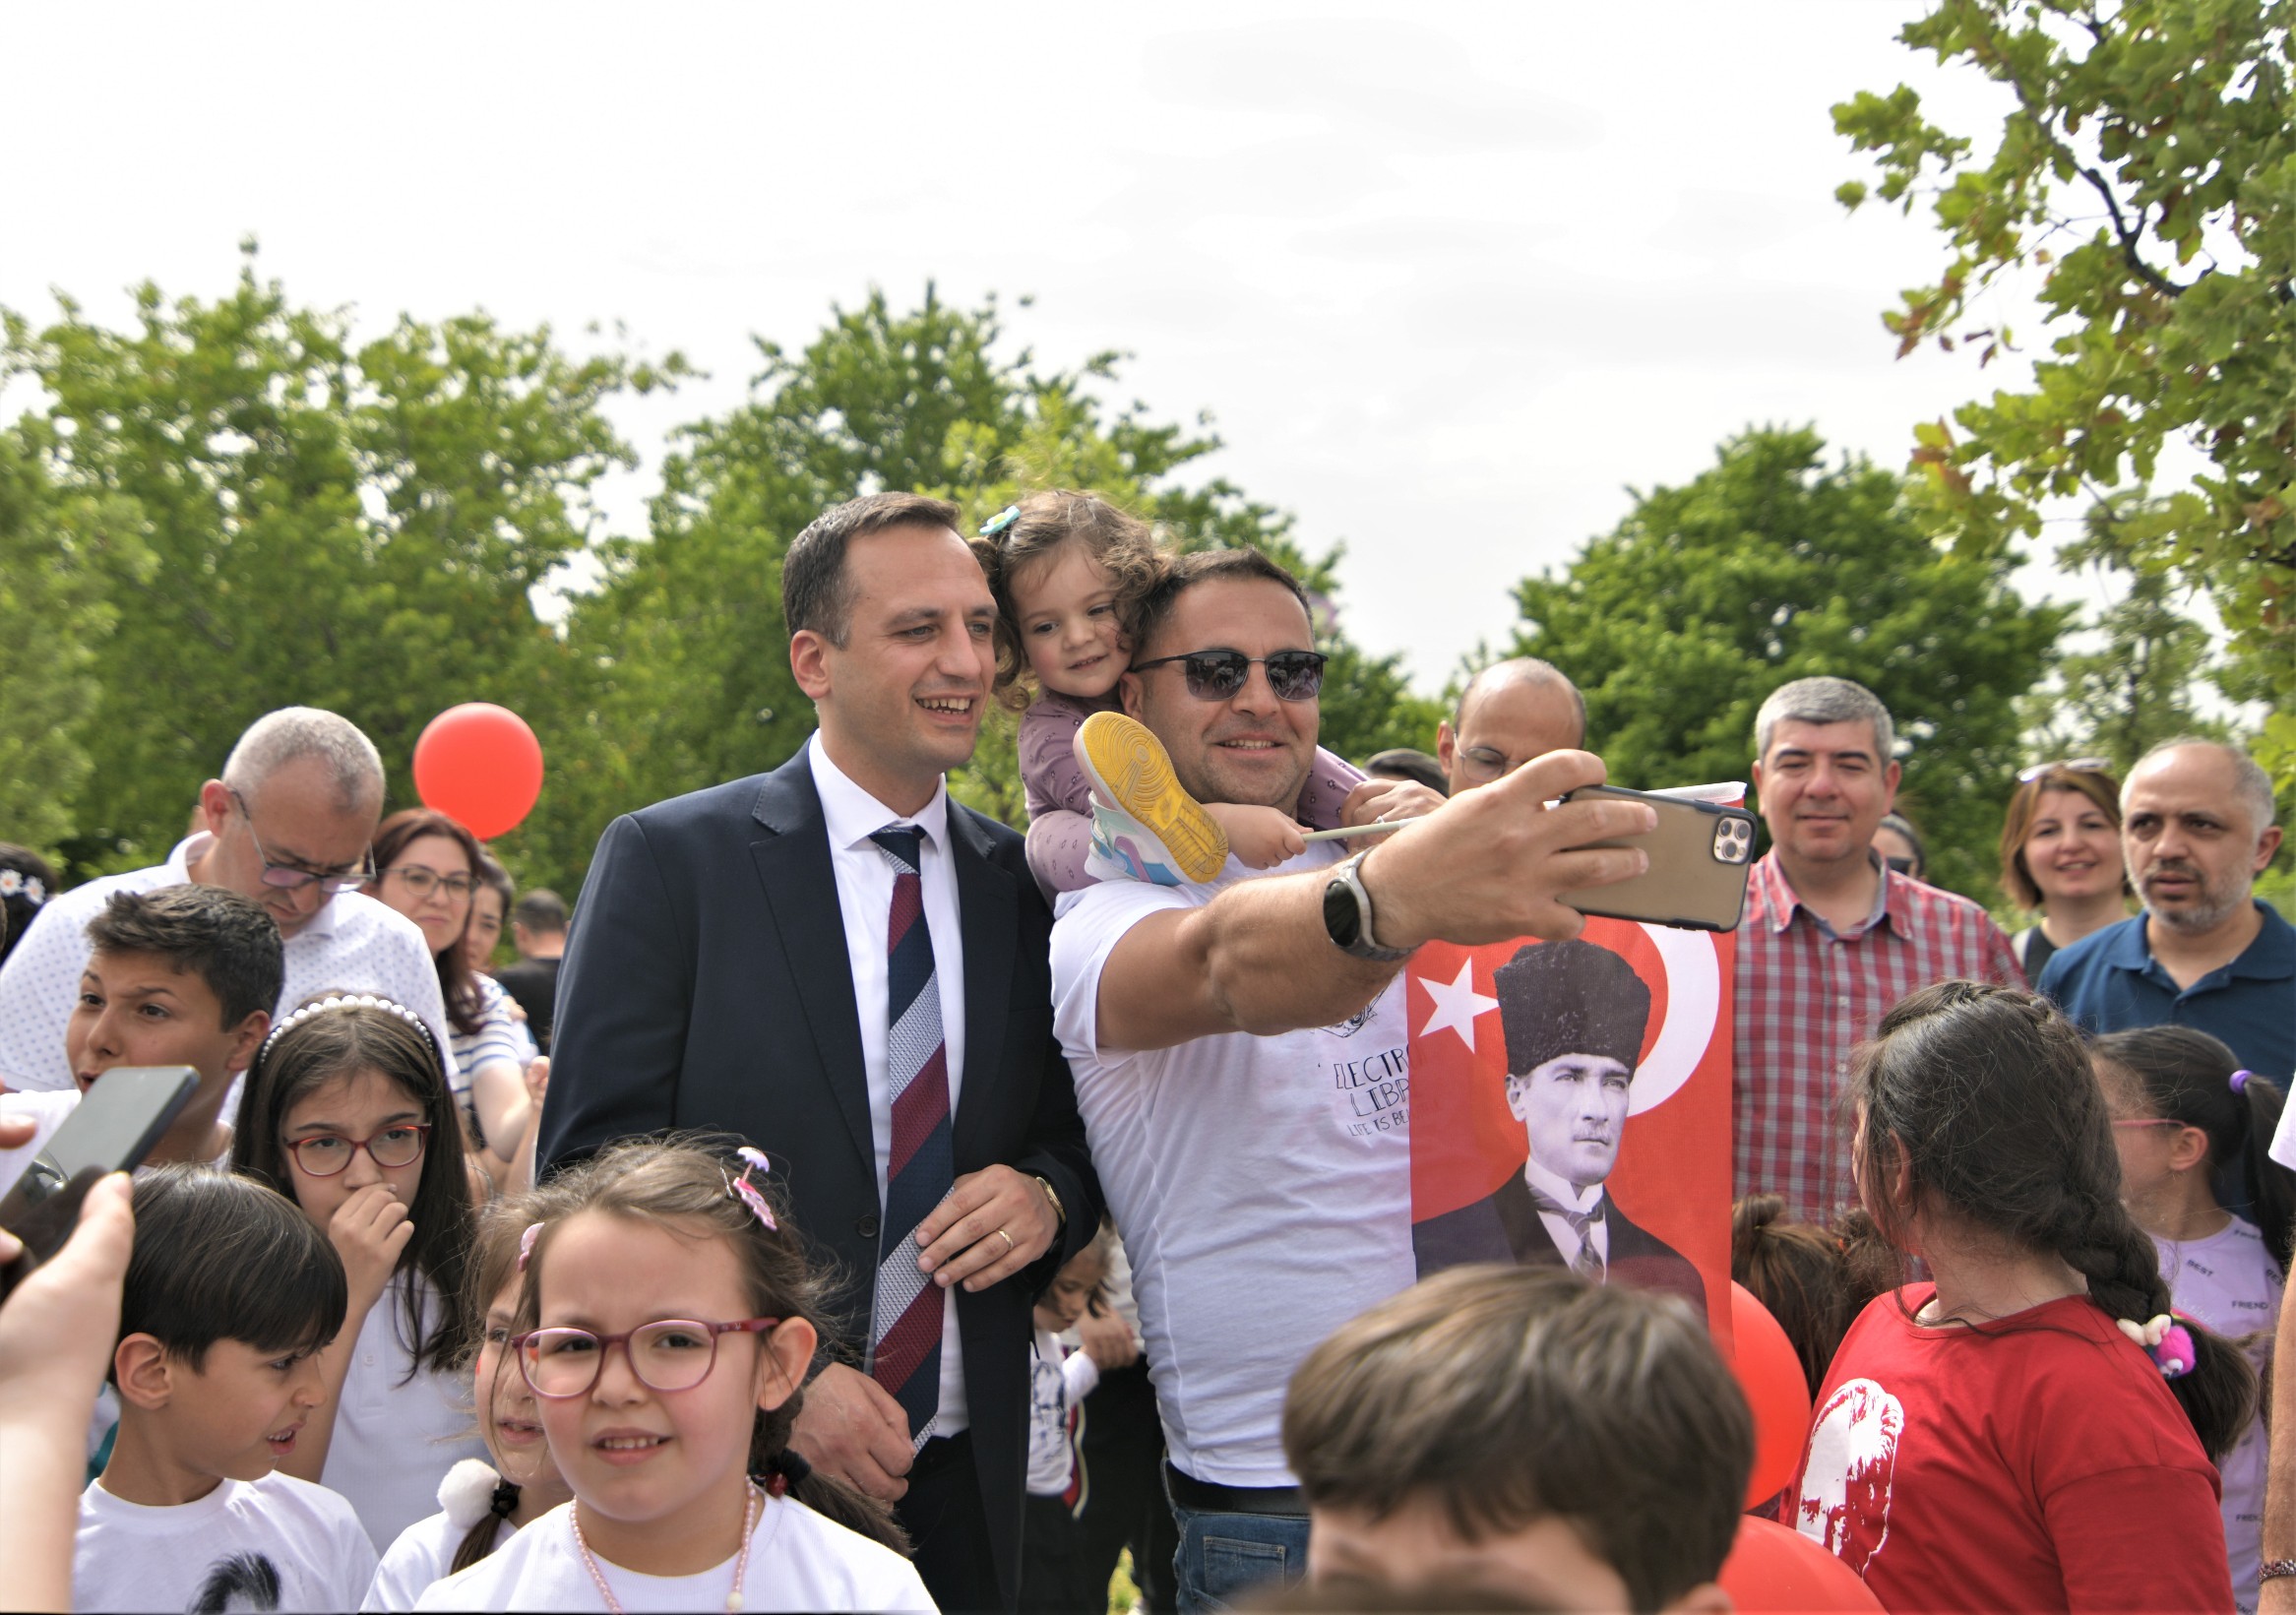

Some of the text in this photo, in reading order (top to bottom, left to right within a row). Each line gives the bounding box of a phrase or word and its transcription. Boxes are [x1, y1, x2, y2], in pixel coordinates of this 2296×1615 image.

[1334, 1044, 1409, 1089] ELECTR
[1346, 1123, 1373, 1137] LIFE
[1373, 1116, 1391, 1132] IS
[2187, 1259, 2213, 1277] BEST
[2231, 1300, 2268, 1310] FRIEND
